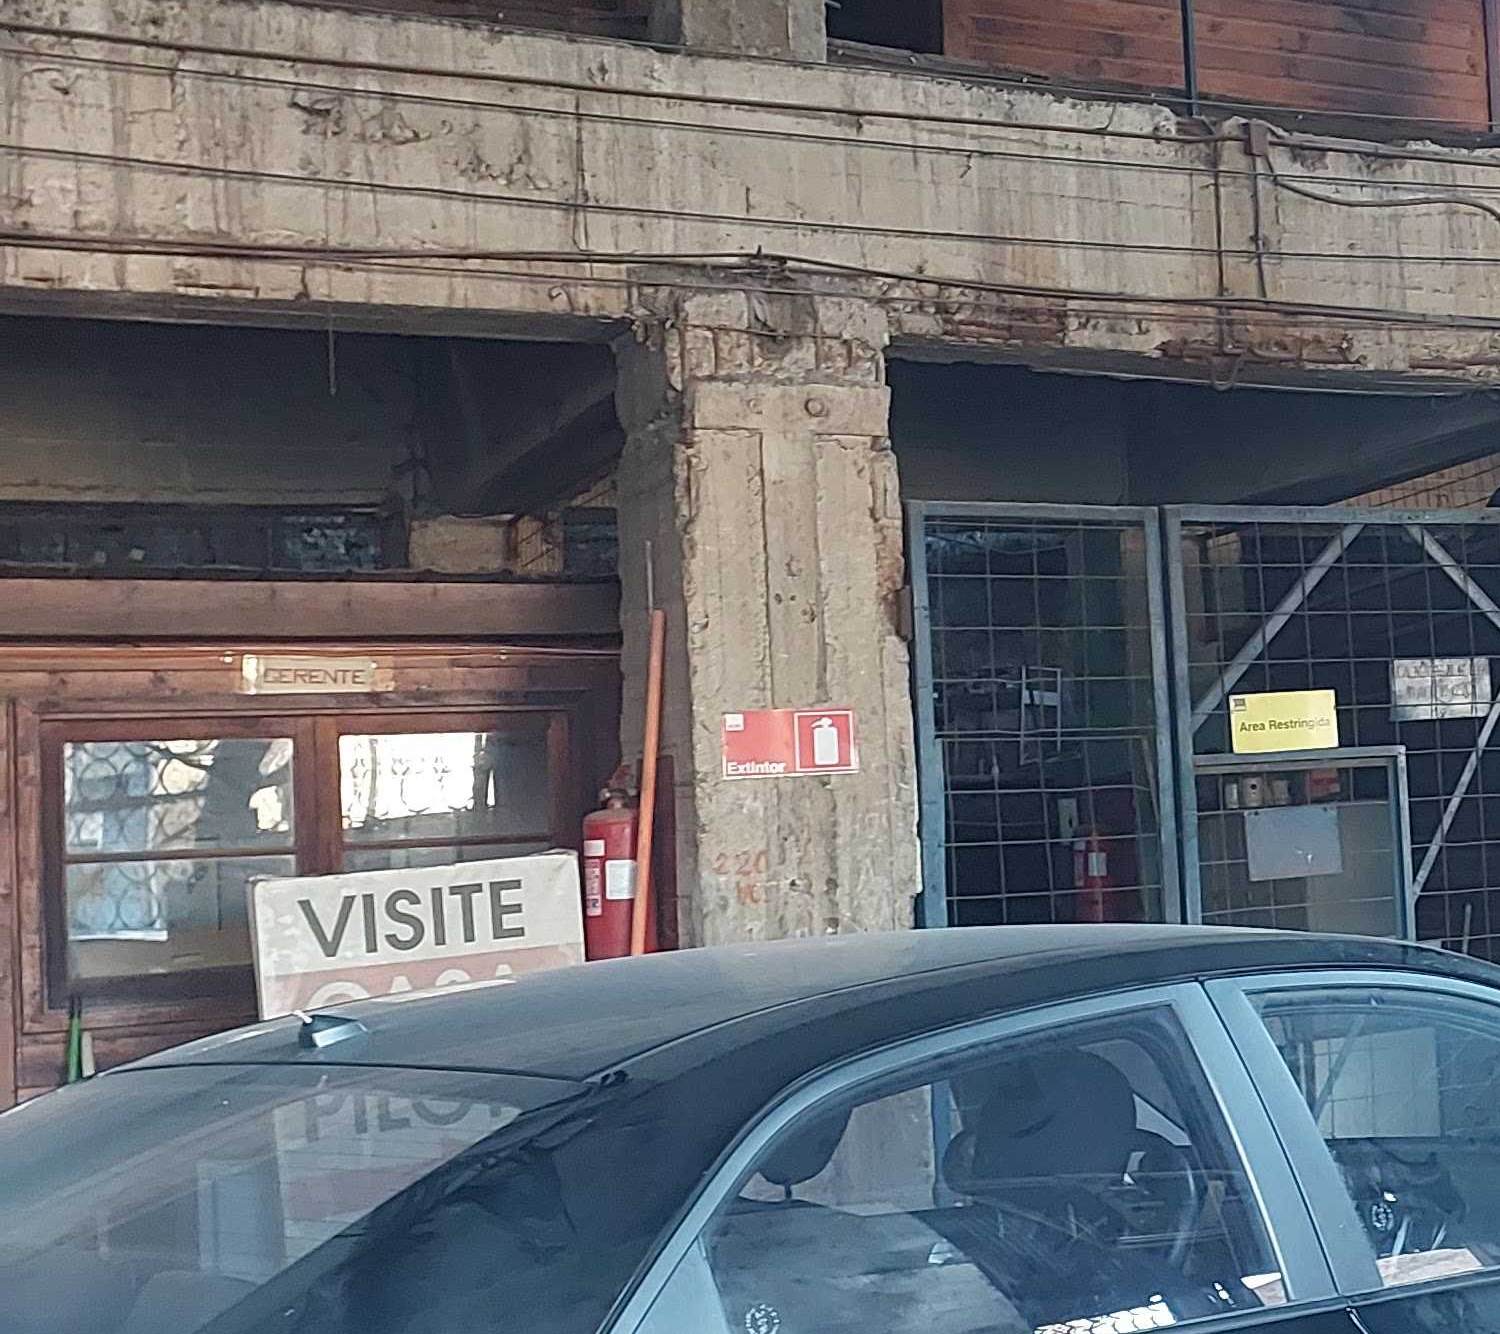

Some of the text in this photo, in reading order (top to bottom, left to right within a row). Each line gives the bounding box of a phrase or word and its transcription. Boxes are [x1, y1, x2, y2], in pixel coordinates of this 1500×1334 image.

[263, 668, 366, 685] GERENTE
[1240, 722, 1266, 732] Area
[727, 761, 786, 774] Extintor
[296, 878, 526, 958] VISITE
